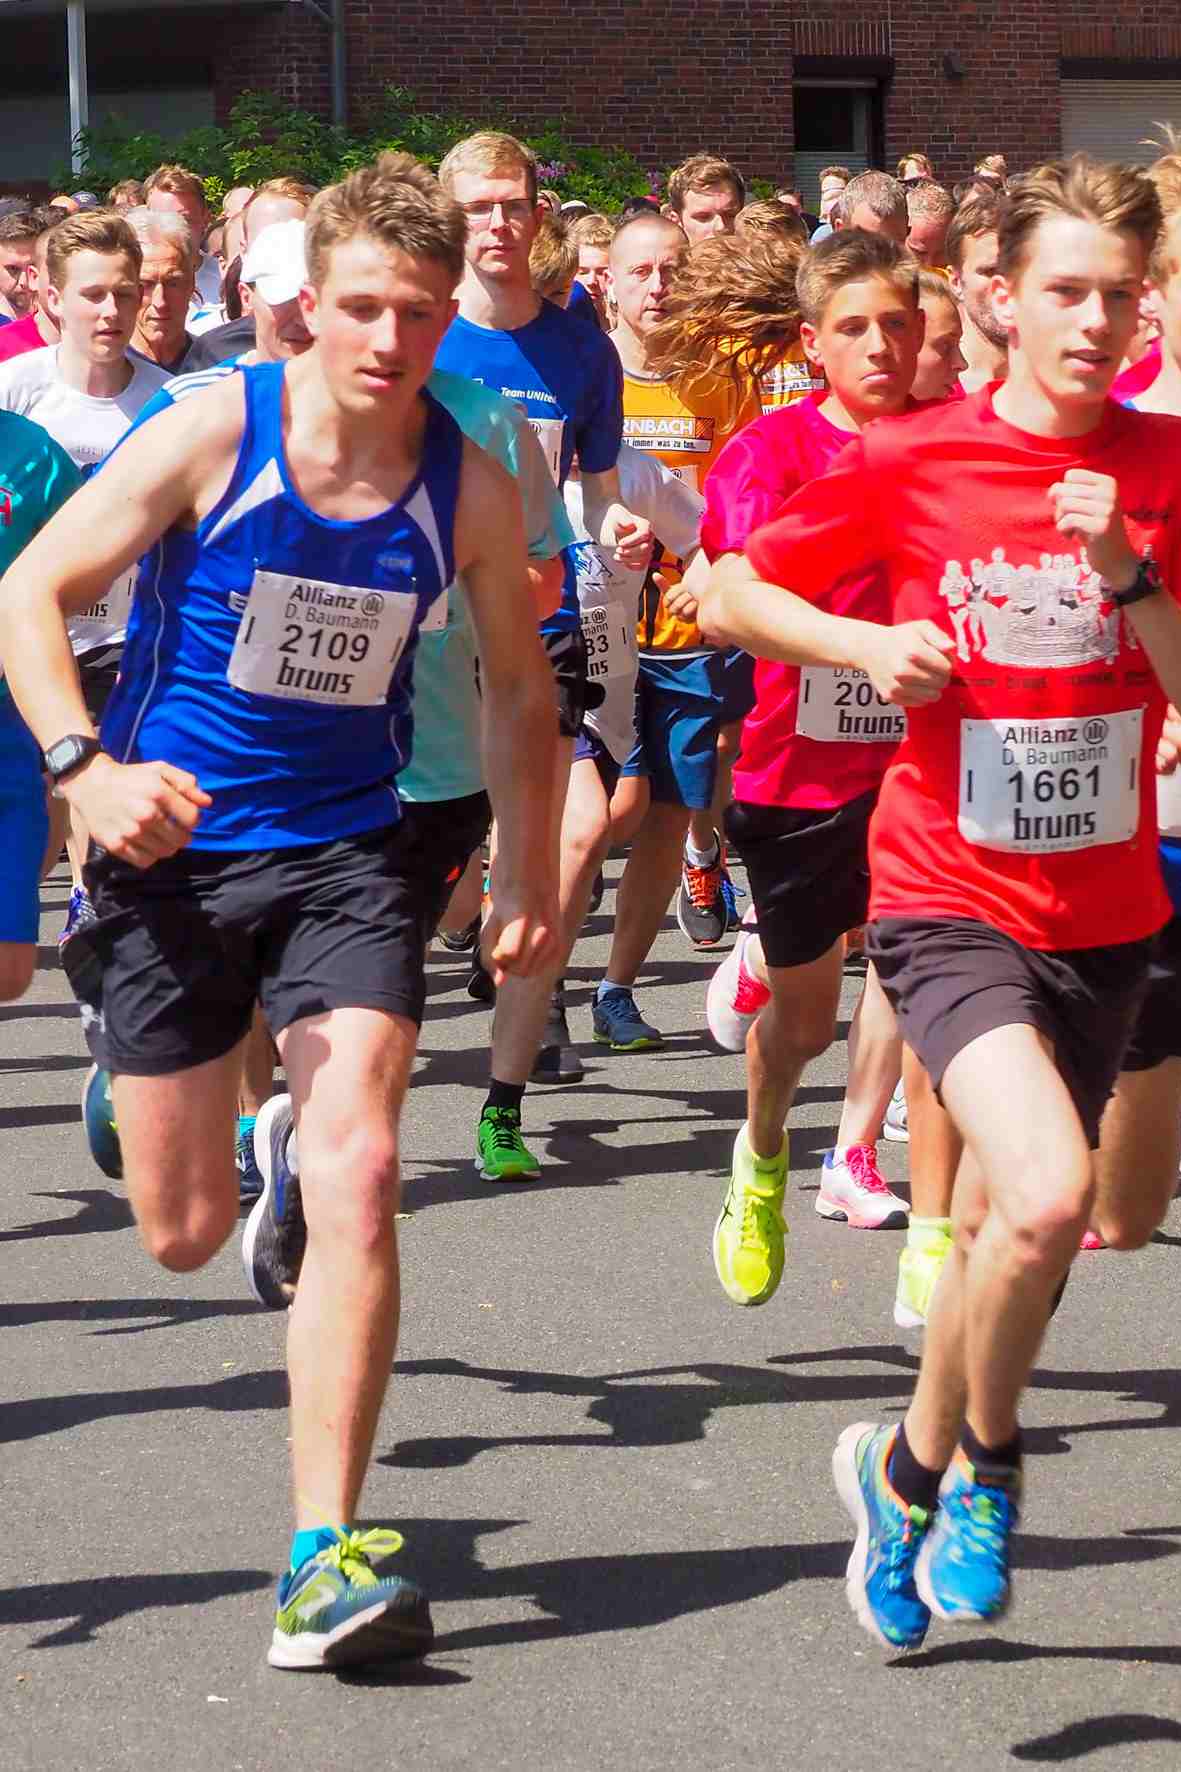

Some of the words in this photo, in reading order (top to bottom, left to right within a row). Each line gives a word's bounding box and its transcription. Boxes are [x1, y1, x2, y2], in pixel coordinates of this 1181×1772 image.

[501, 387, 525, 398] Team
[623, 416, 694, 435] RNBACH
[290, 584, 357, 611] Allianz
[284, 603, 301, 622] D.
[305, 606, 380, 631] Baumann
[278, 623, 371, 663] 2109
[585, 634, 609, 657] 83
[276, 656, 356, 694] bruns
[833, 681, 890, 706] 20
[838, 709, 905, 734] bruns
[1002, 726, 1079, 745] Allianz
[1002, 748, 1020, 766] D.
[1026, 746, 1109, 765] Baumann
[1007, 764, 1100, 803] 1661
[1014, 808, 1096, 841] bruns
